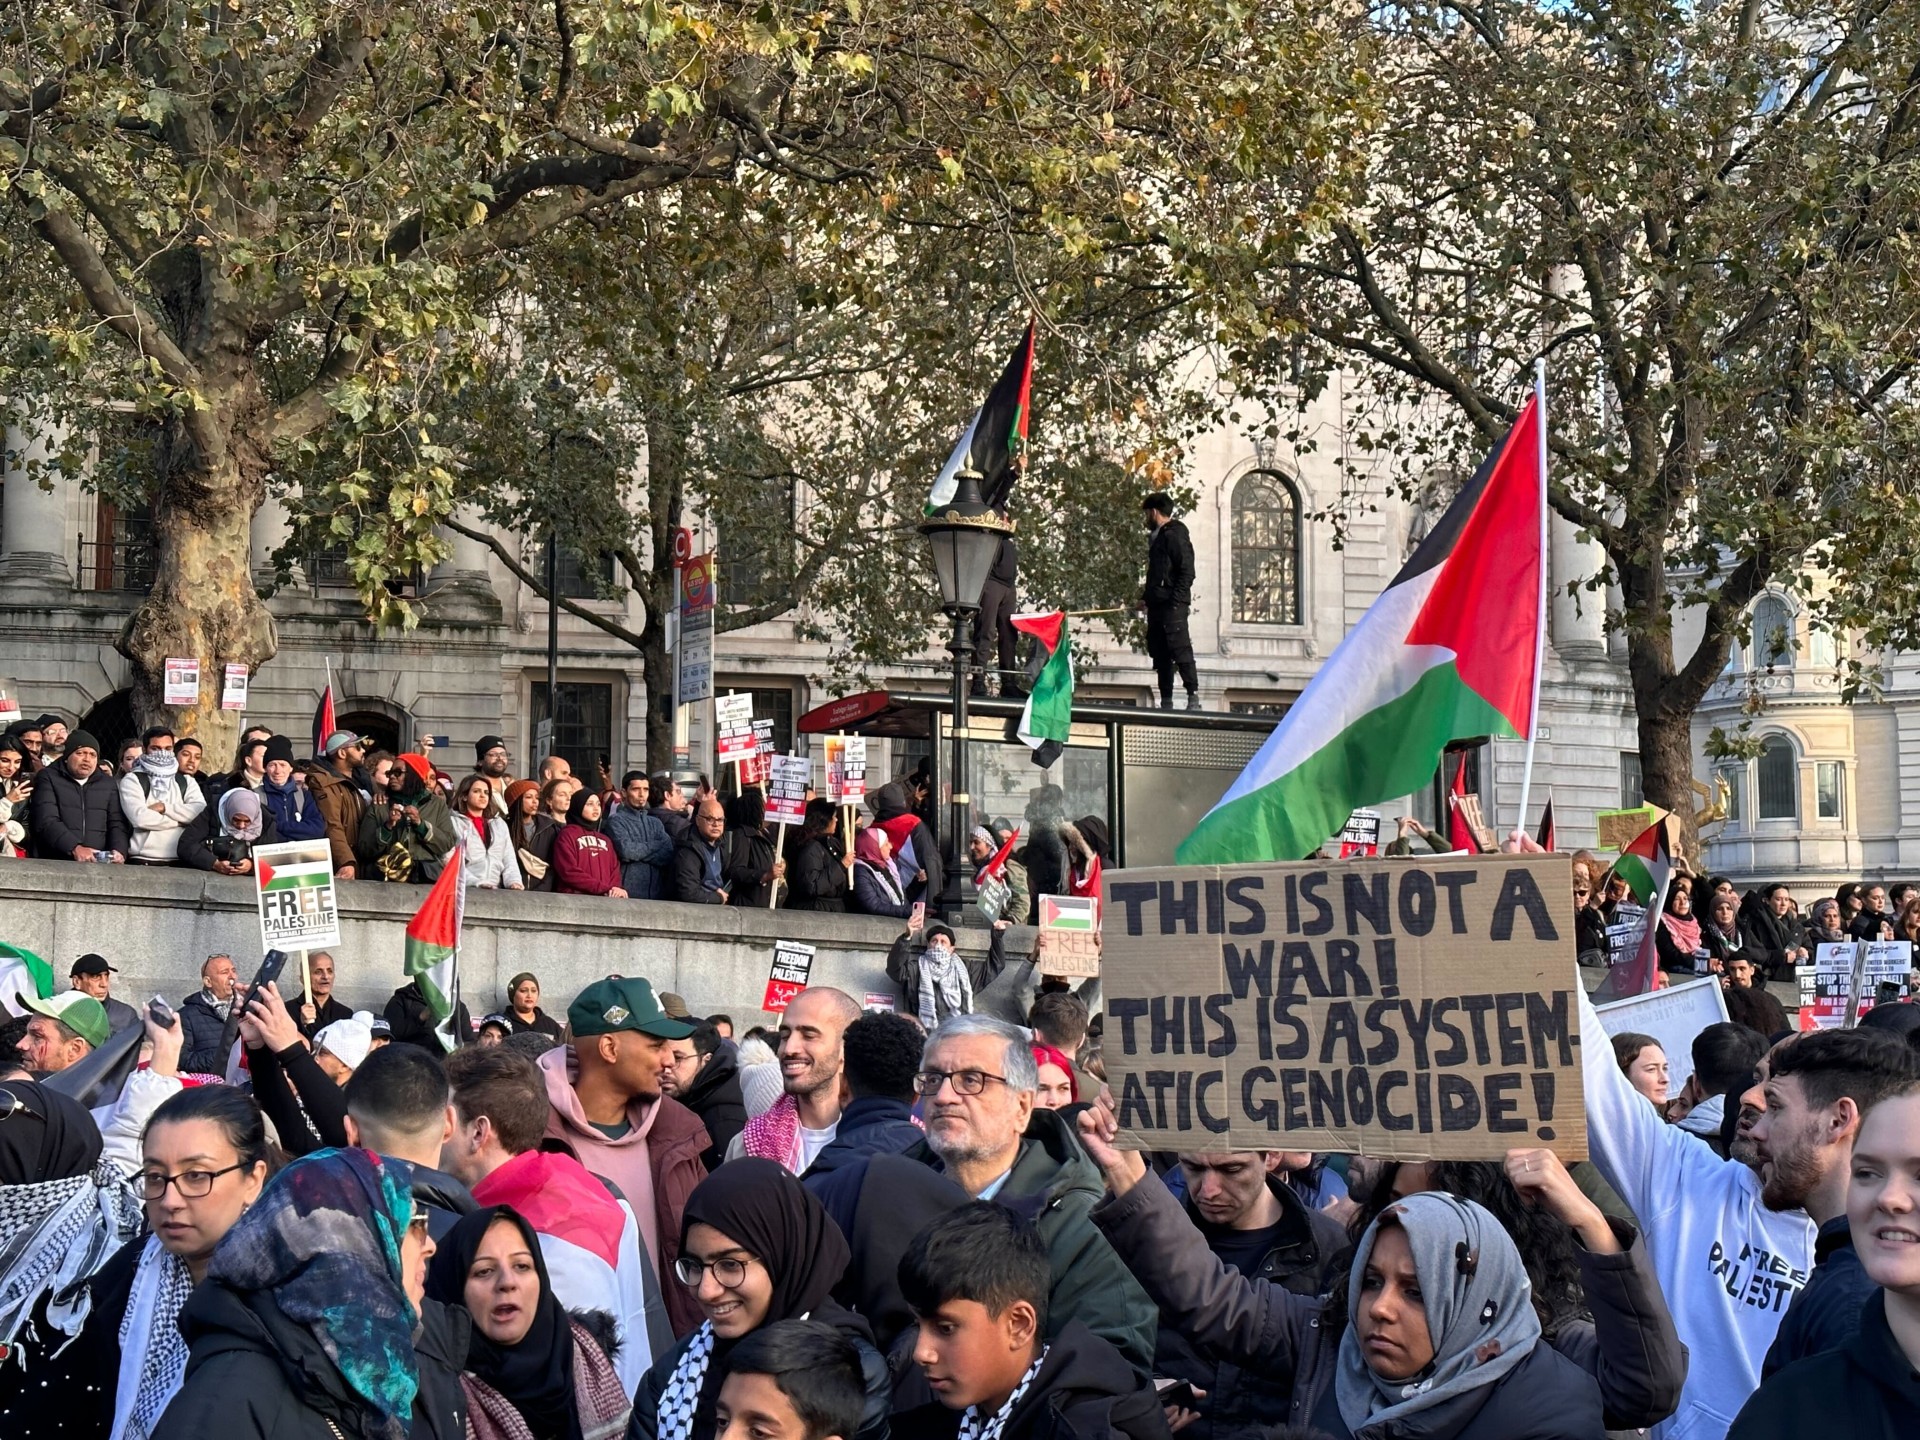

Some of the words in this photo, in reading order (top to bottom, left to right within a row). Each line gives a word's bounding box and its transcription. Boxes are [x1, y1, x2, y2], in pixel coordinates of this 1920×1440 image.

[675, 532, 686, 558] C
[1343, 832, 1377, 844] PALESTINE
[262, 886, 334, 918] FREE
[1110, 876, 1266, 936] THIS
[1284, 871, 1334, 936] IS
[1342, 869, 1478, 937] NOT
[1490, 868, 1559, 941] A
[264, 912, 335, 932] PALESTINE
[1044, 930, 1096, 956] FREE
[776, 950, 810, 968] FREEDOM
[1042, 956, 1096, 973] PALESTINE
[1222, 938, 1400, 999] WAR!
[770, 967, 808, 984] PALESTINE
[1817, 975, 1837, 984] STOP
[1827, 986, 1838, 996] ON
[1840, 985, 1850, 996] GA
[1862, 986, 1876, 996] ATE
[1820, 998, 1832, 1006] FOR
[1833, 998, 1838, 1006] A
[1108, 994, 1237, 1058] THIS
[1256, 994, 1310, 1060] IS
[1319, 1001, 1366, 1066] A
[1118, 1070, 1231, 1134] ATIC
[1241, 1066, 1556, 1141] GENOCIDE!
